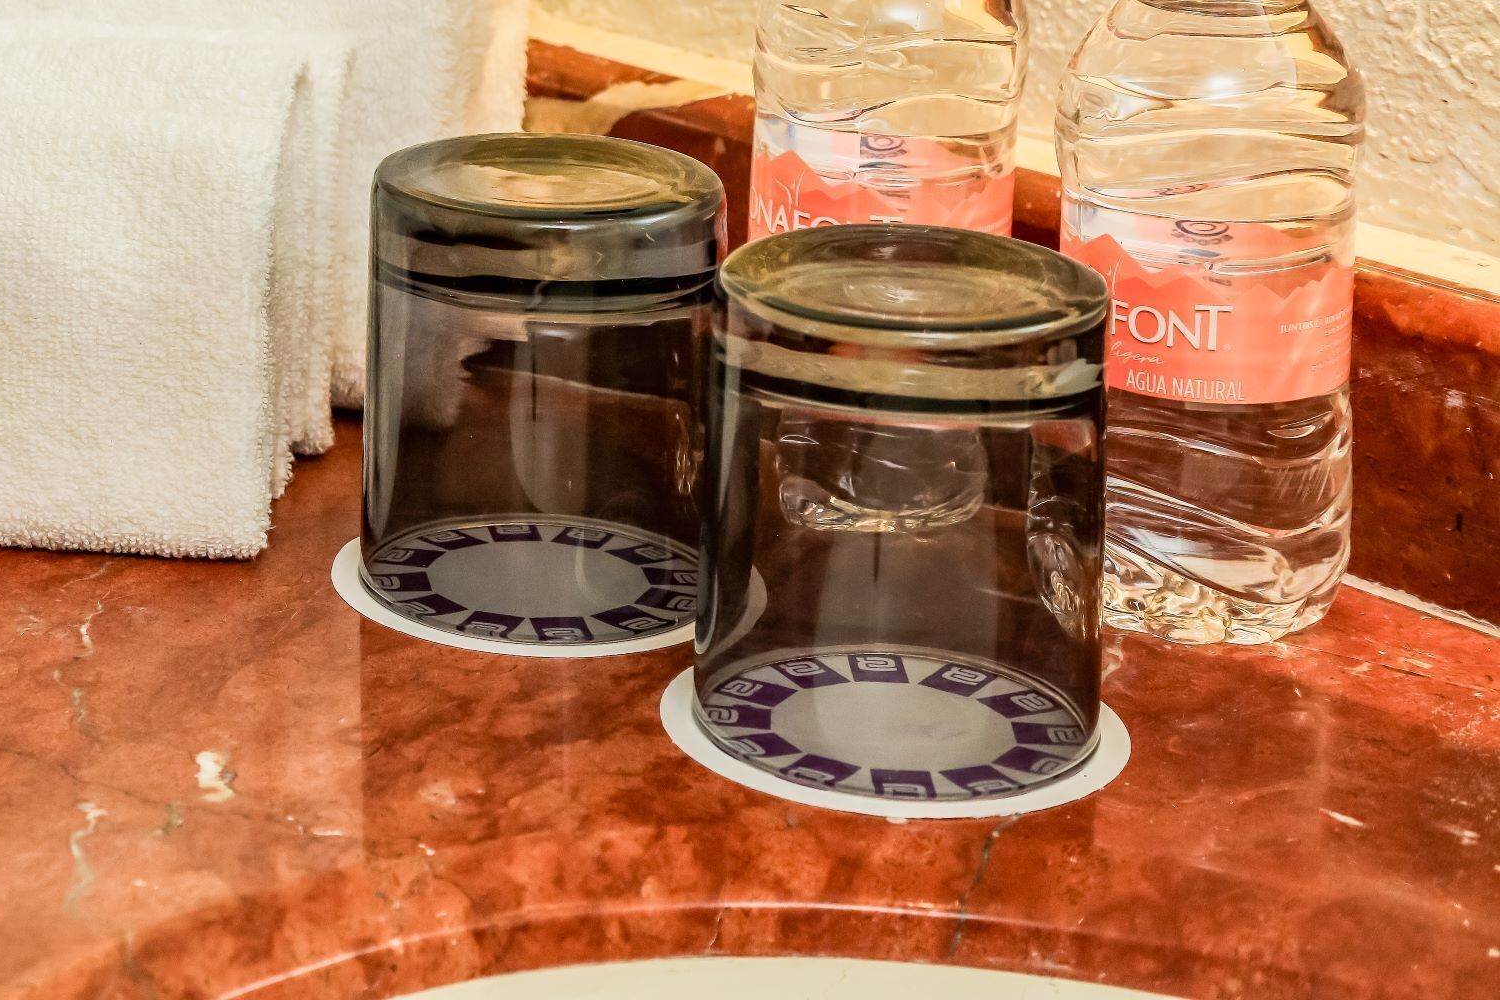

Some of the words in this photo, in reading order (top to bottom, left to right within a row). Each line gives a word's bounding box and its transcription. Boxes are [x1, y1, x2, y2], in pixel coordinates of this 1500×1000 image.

[1110, 299, 1234, 351] FONT
[1126, 368, 1167, 395] AGUA
[1172, 377, 1245, 401] NATURAL
